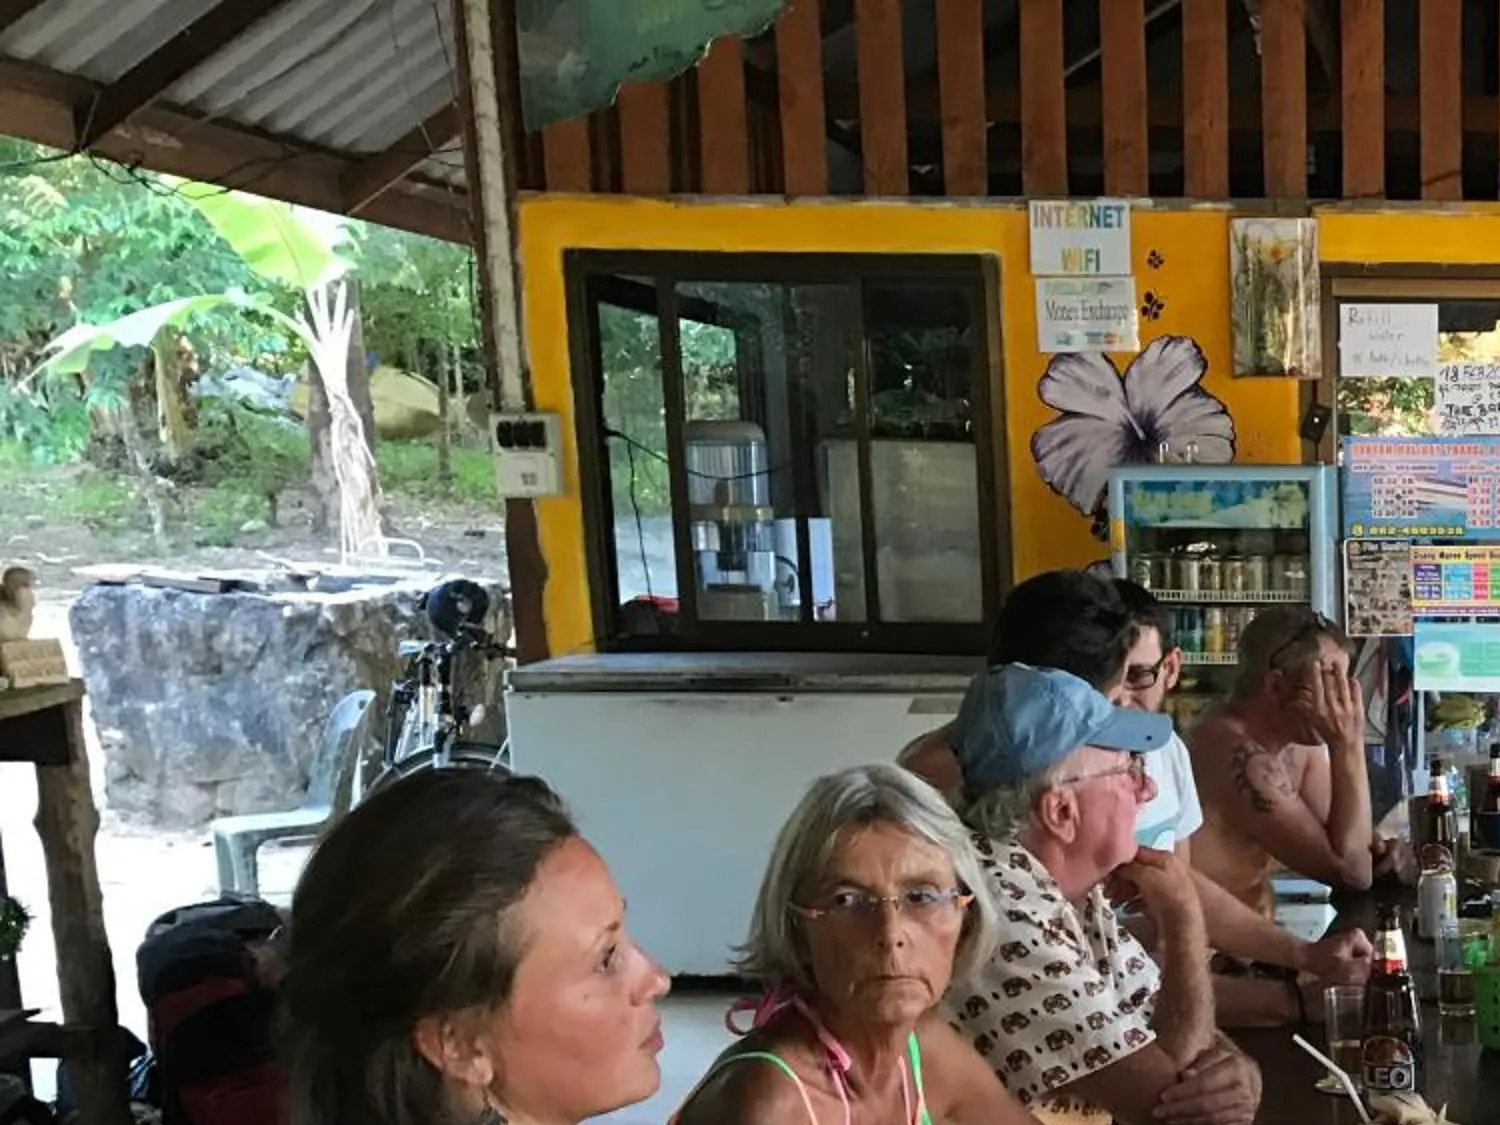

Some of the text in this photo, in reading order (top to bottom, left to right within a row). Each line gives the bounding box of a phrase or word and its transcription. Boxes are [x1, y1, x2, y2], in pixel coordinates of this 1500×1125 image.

[1033, 204, 1125, 229] INTERNET
[1062, 248, 1100, 273] WIFI
[1045, 299, 1130, 326] Money Exchange
[1363, 1065, 1412, 1090] LEO
